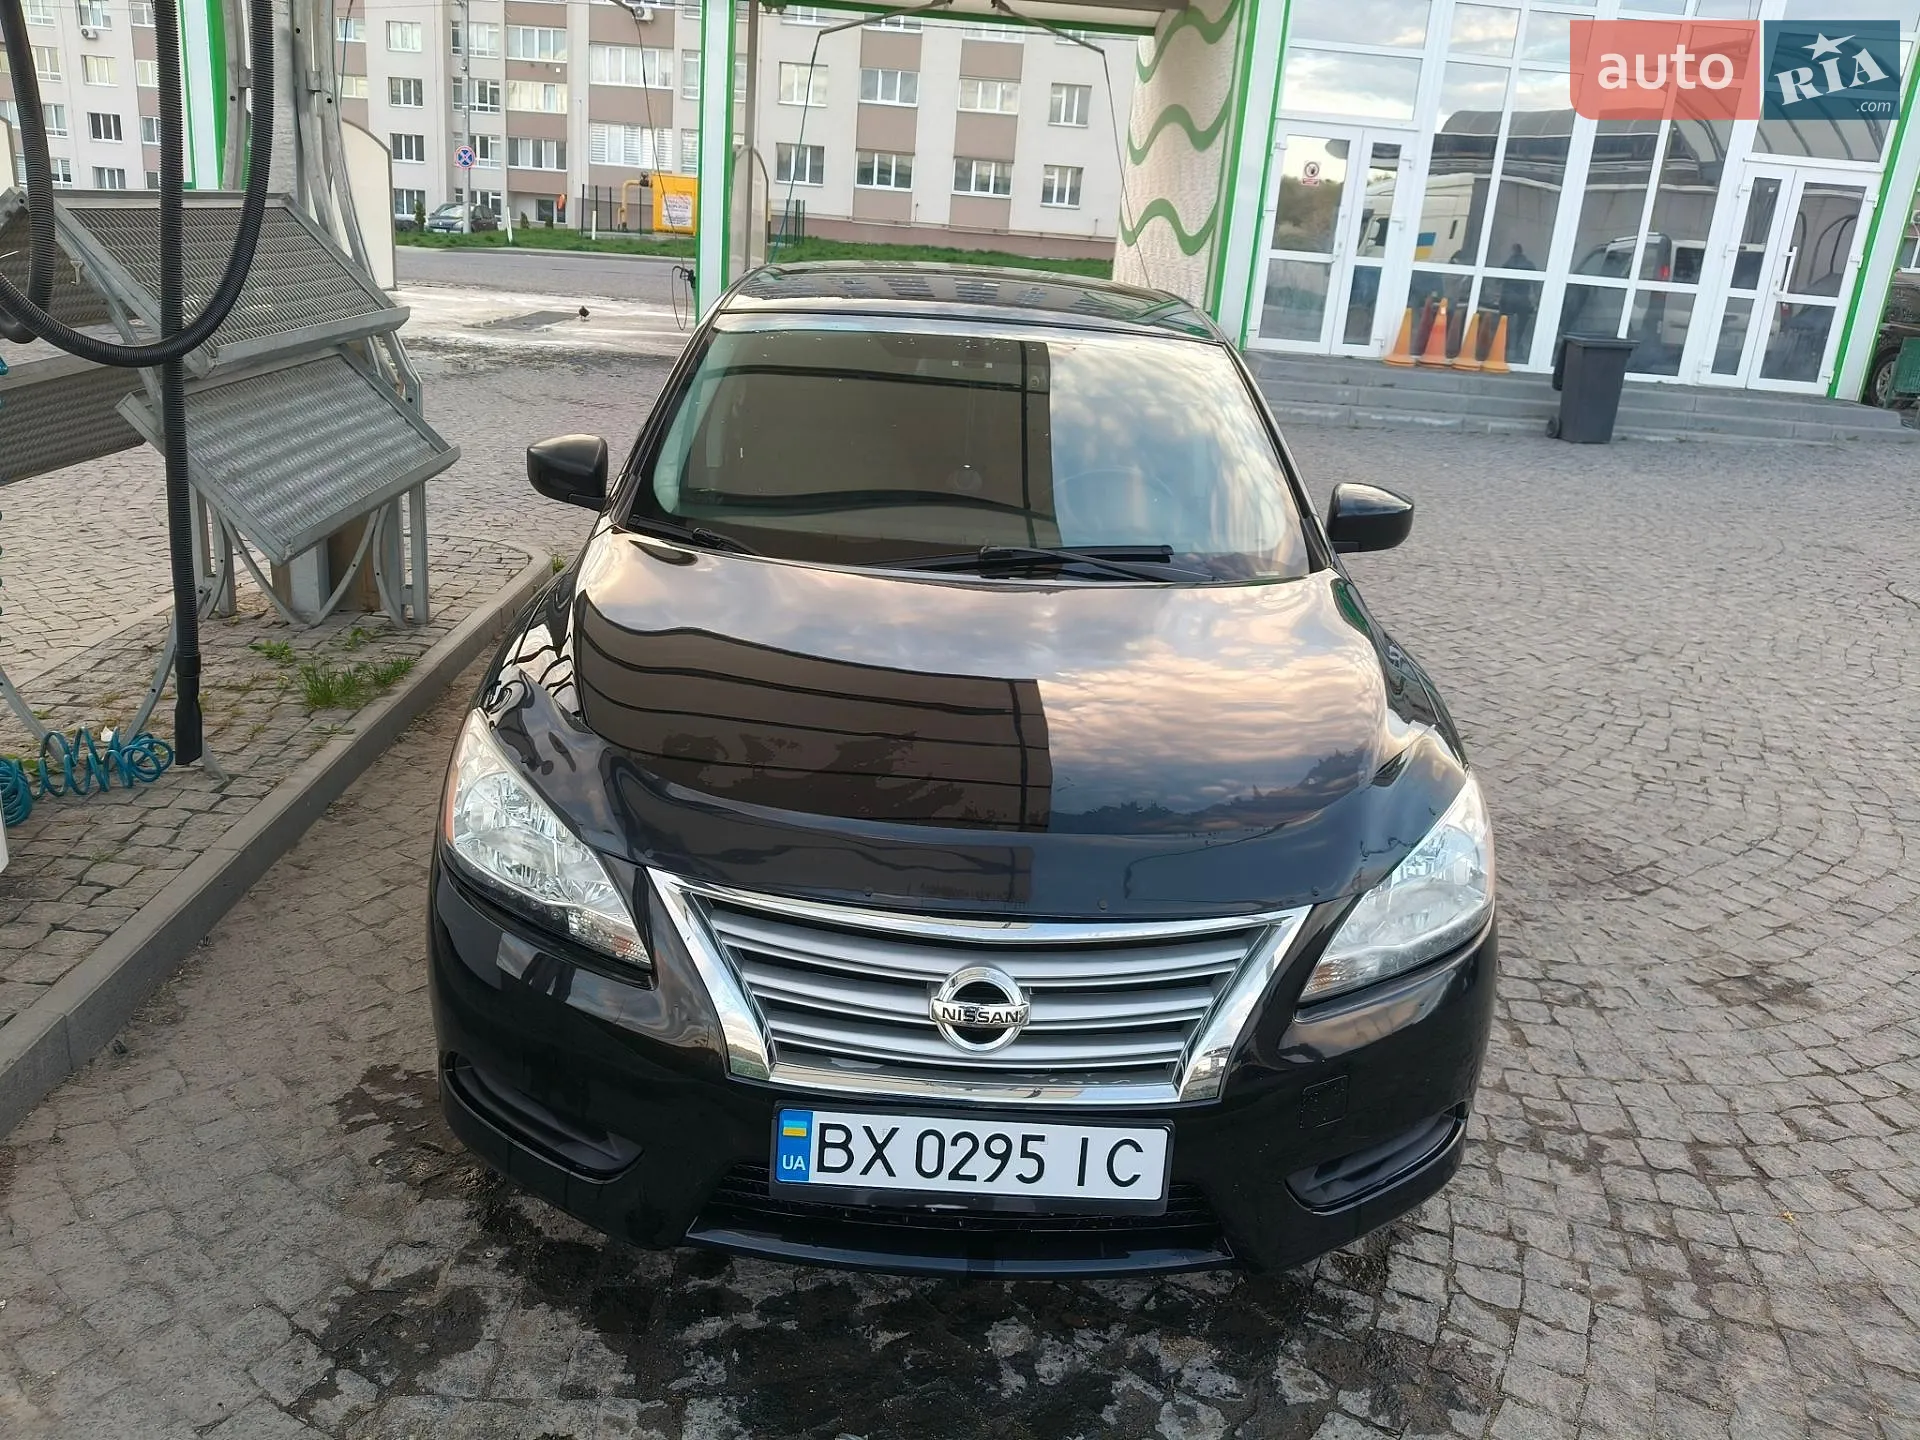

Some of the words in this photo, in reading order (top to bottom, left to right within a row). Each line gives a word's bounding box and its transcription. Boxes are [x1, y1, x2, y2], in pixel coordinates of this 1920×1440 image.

[942, 1006, 1019, 1024] NISSAN
[782, 1154, 806, 1171] UA
[816, 1122, 900, 1178] BX
[915, 1128, 1046, 1184] 0295
[1077, 1136, 1144, 1188] IC
